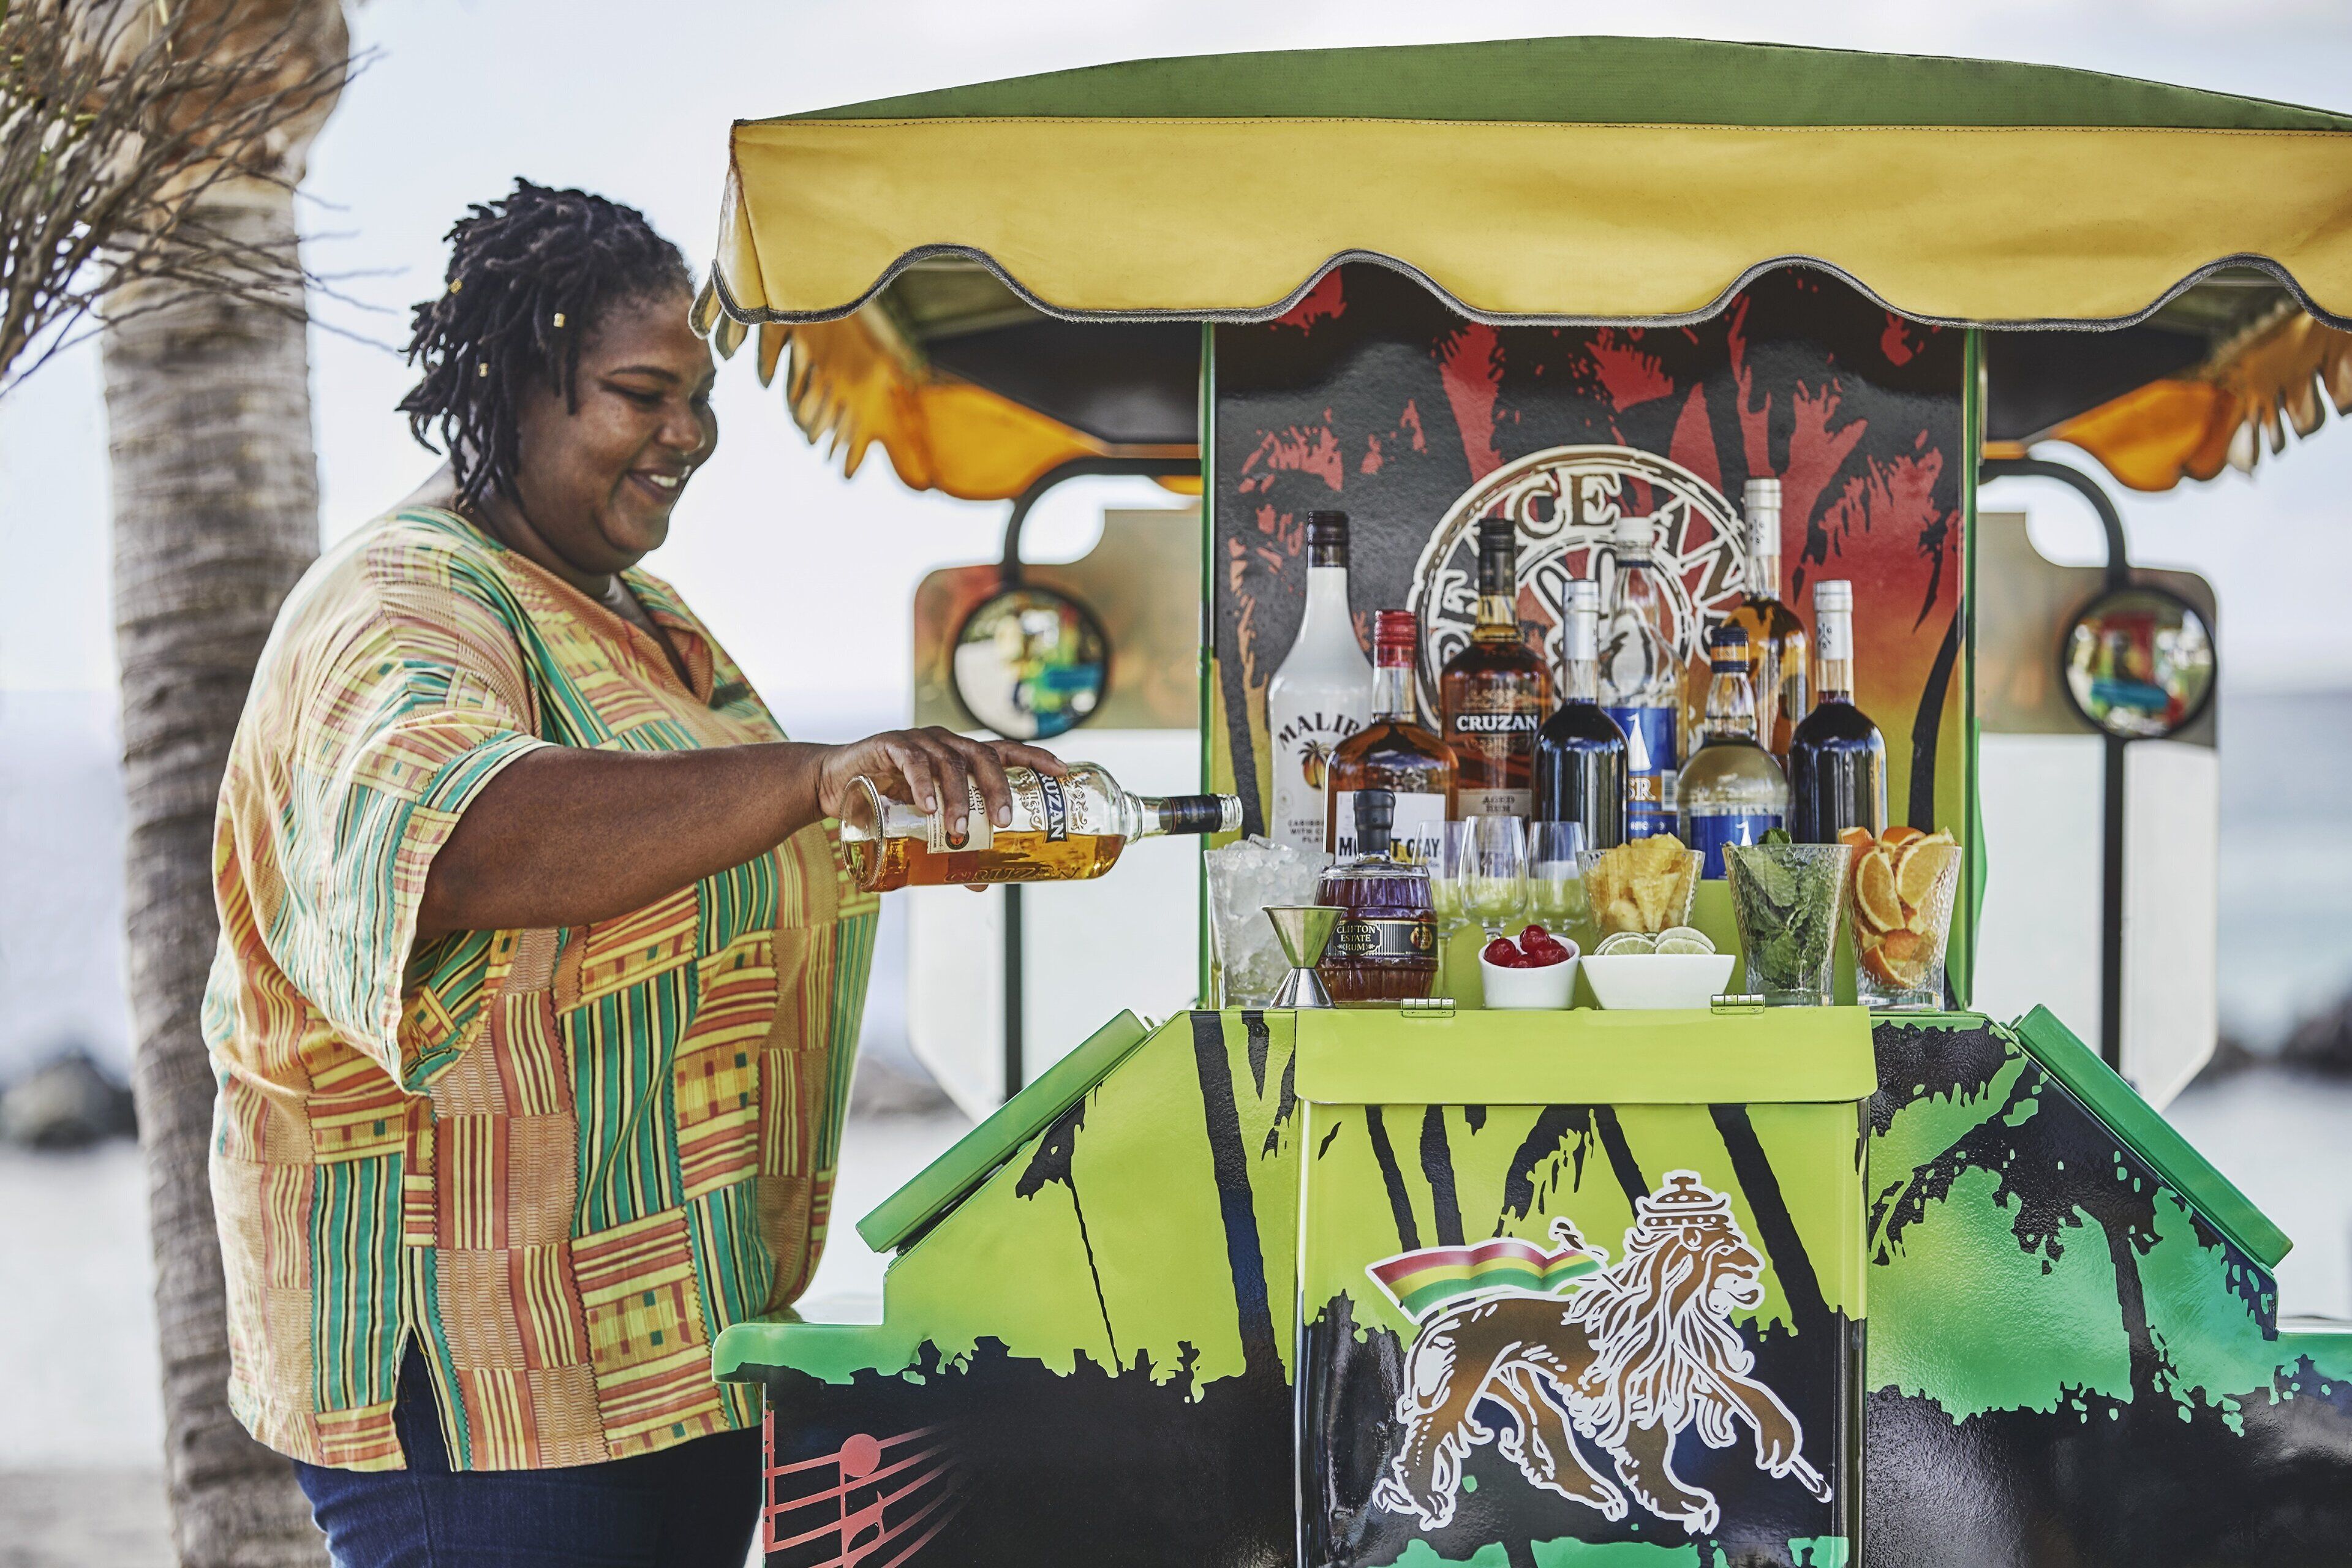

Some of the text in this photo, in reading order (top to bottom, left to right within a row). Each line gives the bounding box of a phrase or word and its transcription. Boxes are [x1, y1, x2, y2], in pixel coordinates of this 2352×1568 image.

[1279, 712, 1360, 750] MALIB
[1456, 715, 1539, 732] CRUZAN
[971, 786, 985, 815] AGED
[1628, 777, 1656, 801] SR
[1039, 774, 1065, 839] RUZAN
[1336, 925, 1376, 934] CLIFTON
